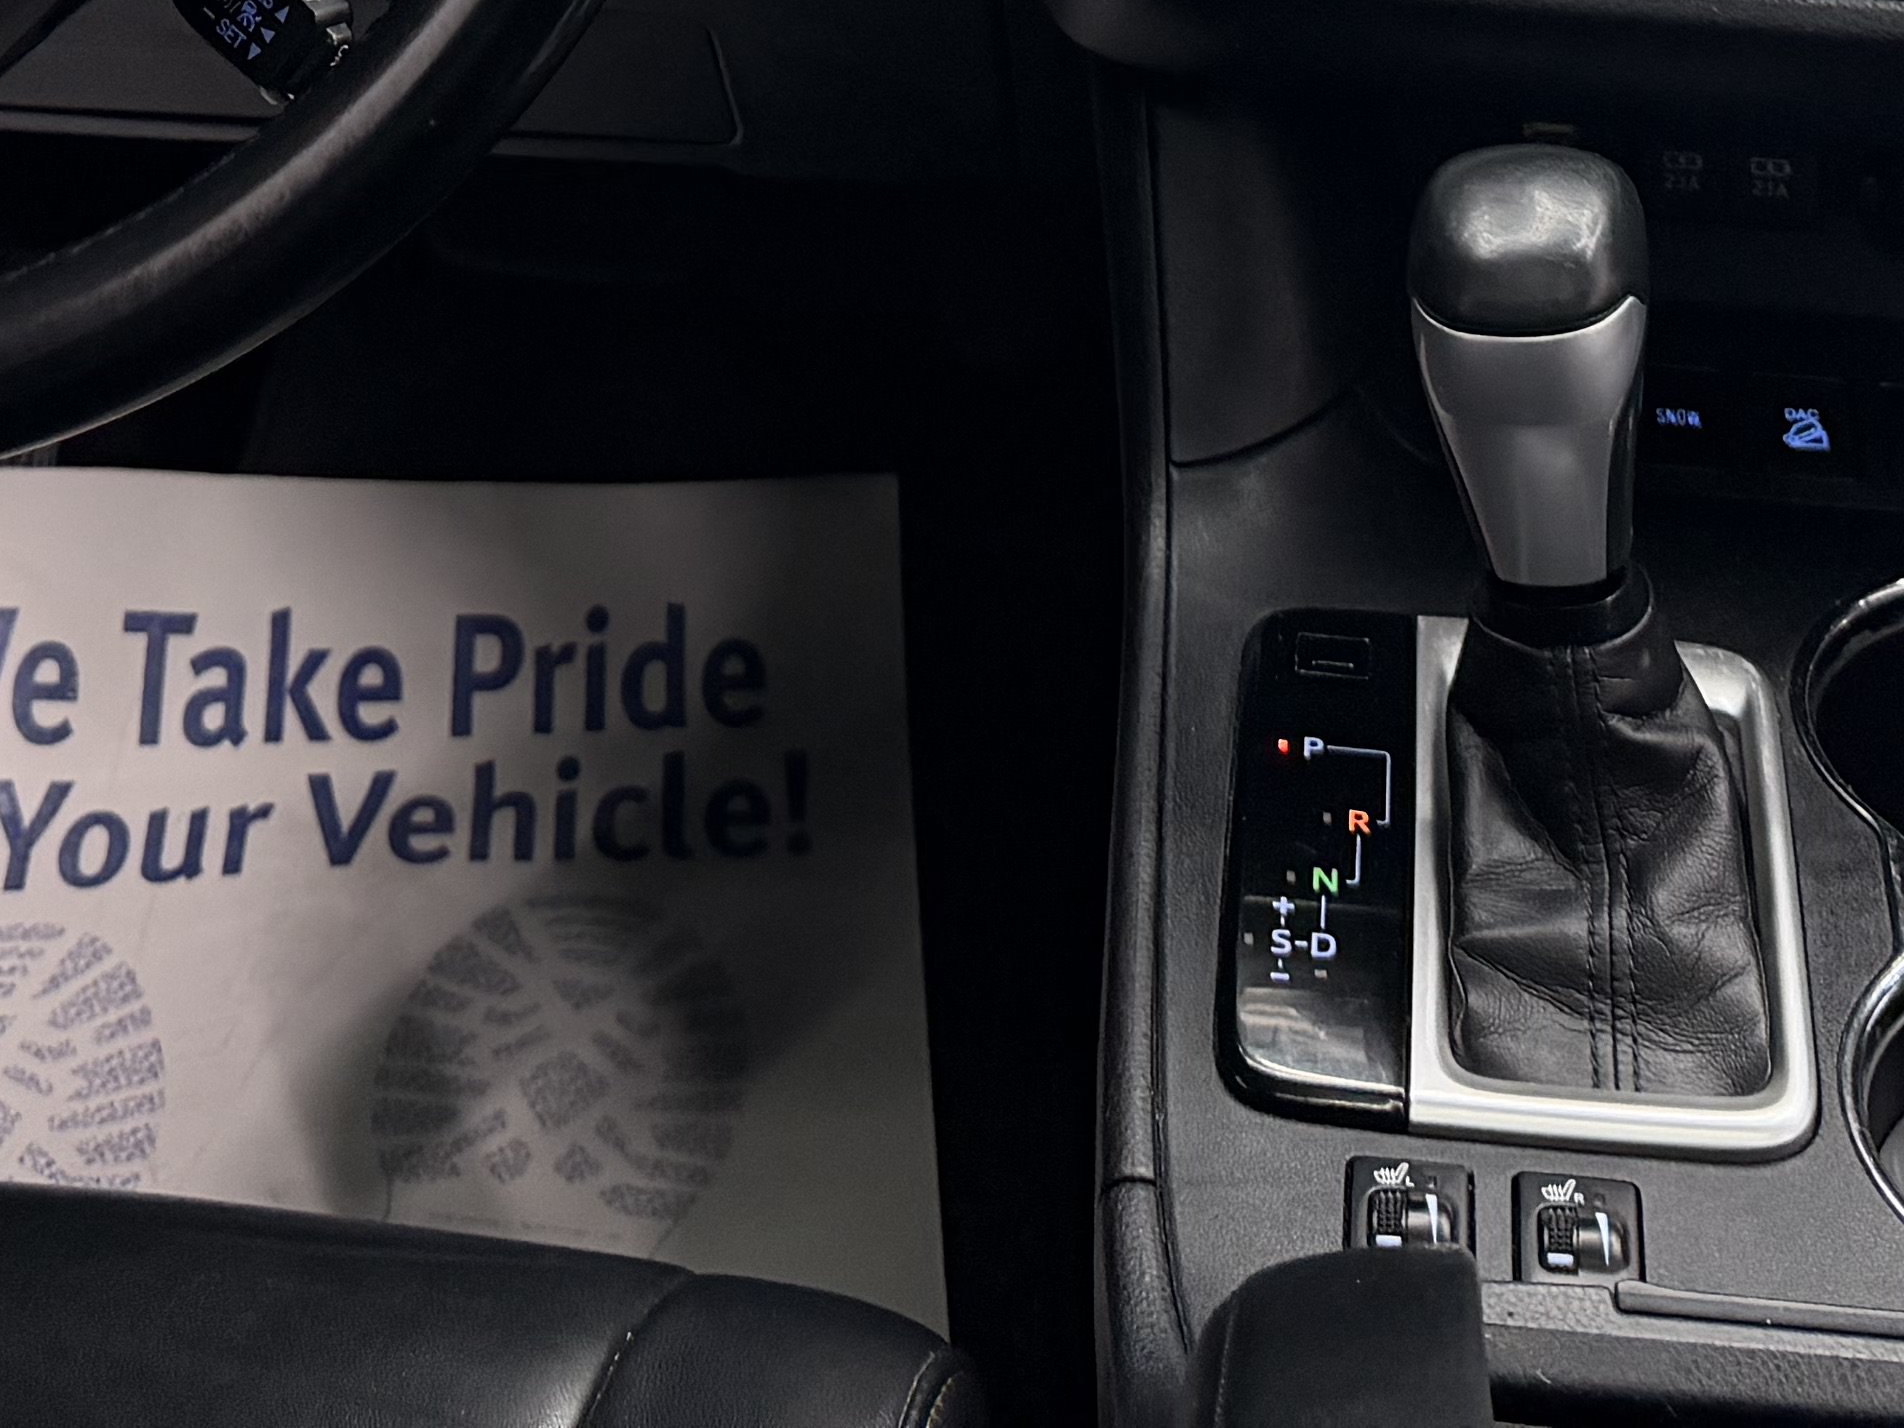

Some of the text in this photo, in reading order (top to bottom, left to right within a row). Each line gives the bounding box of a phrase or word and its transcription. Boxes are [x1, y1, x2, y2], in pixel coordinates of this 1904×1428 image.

[215, 17, 247, 49] SET
[122, 607, 405, 747] Take
[450, 603, 768, 739] Pride
[1303, 736, 1325, 760] P
[306, 749, 814, 870] Vehicle!
[1348, 808, 1371, 835] R
[1312, 866, 1339, 894] N
[1269, 929, 1293, 957] S
[1310, 933, 1337, 960] D
